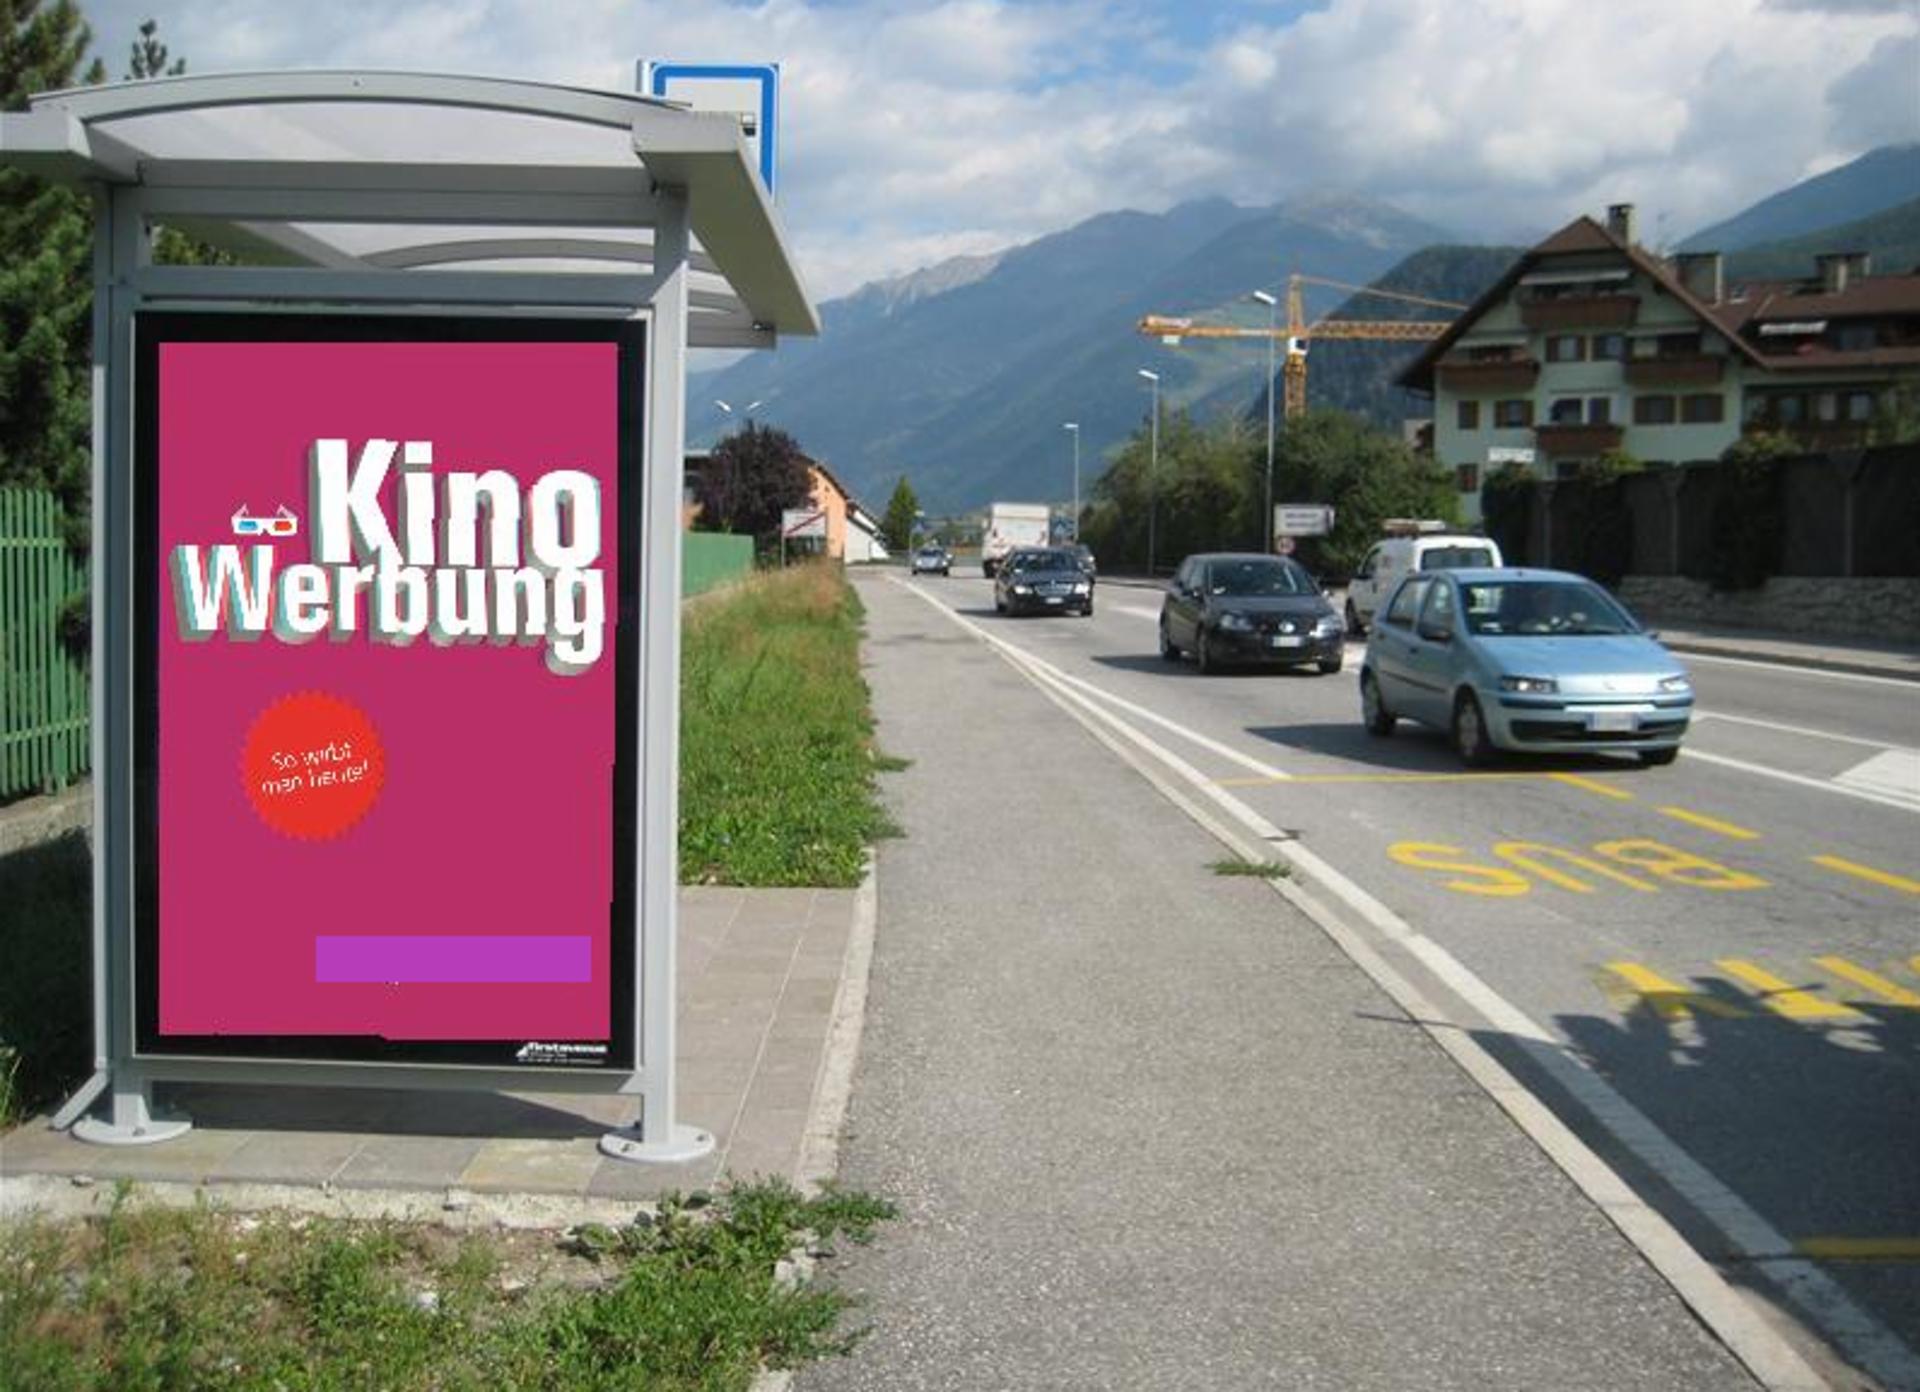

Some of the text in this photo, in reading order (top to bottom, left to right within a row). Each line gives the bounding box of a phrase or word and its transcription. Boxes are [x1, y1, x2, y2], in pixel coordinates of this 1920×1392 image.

[309, 438, 600, 568] Kino
[170, 545, 605, 672] Werbung
[271, 751, 298, 771] So
[1387, 837, 1771, 896] BUS
